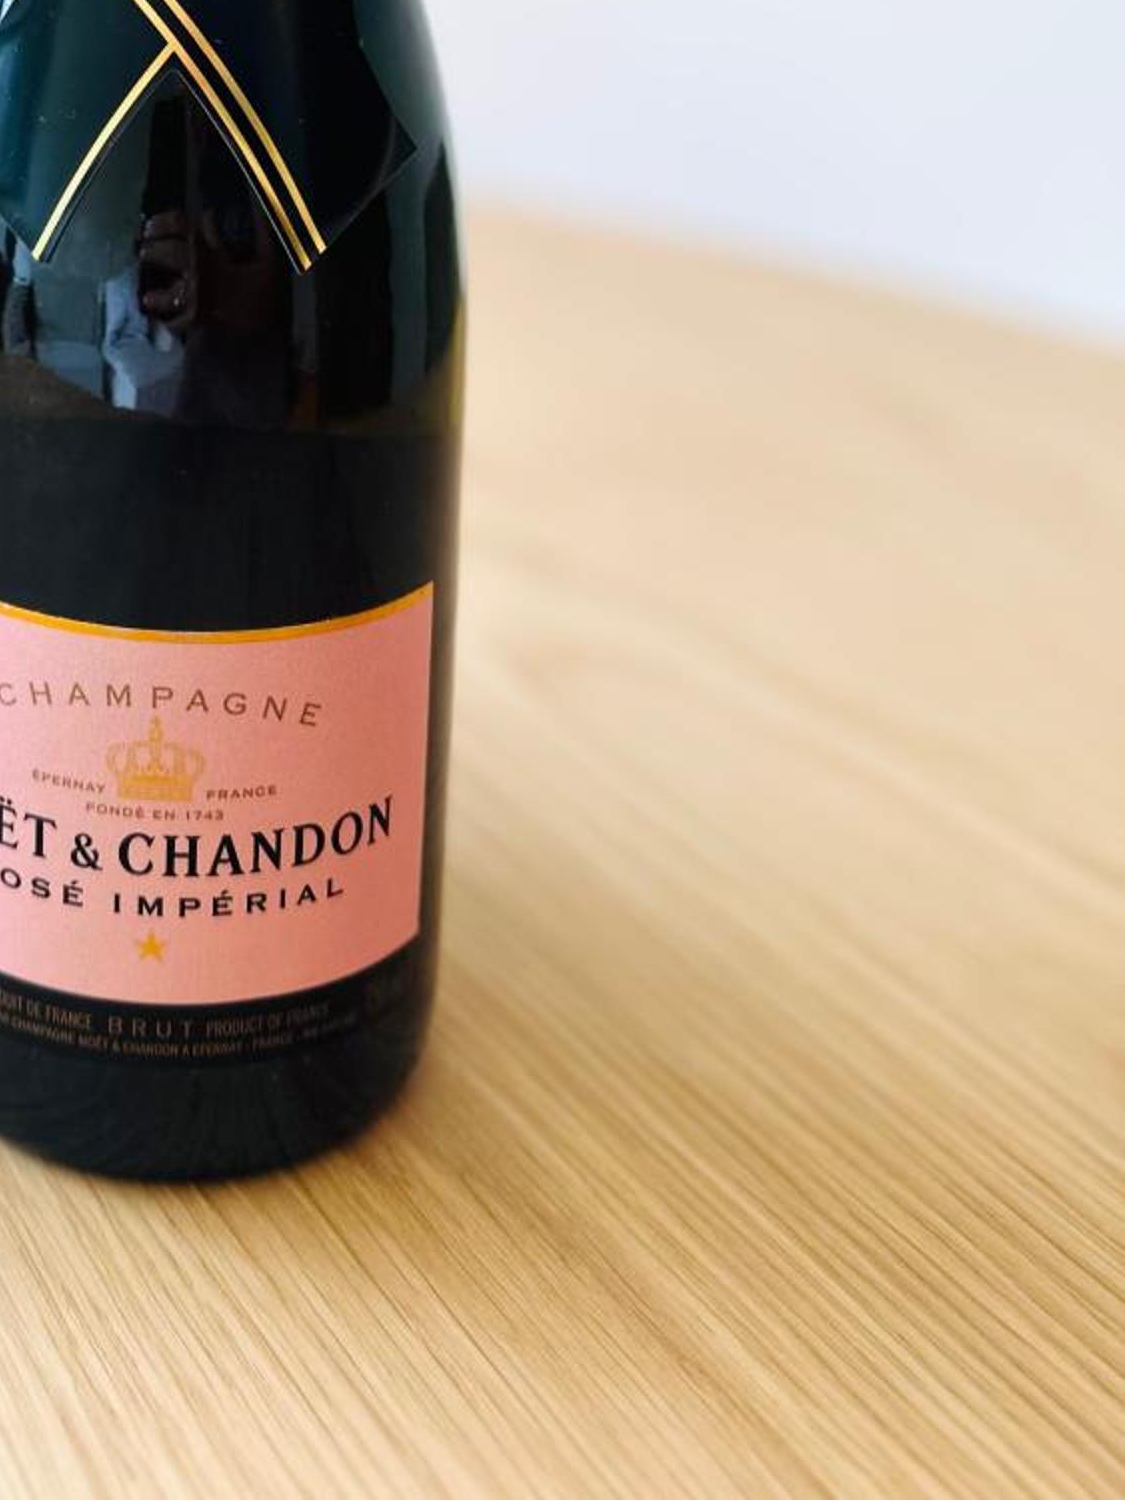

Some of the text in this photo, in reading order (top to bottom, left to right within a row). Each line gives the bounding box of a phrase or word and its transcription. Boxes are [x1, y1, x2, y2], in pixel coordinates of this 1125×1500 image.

[206, 784, 278, 800] FRANCE
[86, 802, 225, 822] FONDÉ EN 1743
[70, 833, 103, 870] &
[118, 795, 394, 878] CHANDON
[113, 877, 345, 918] IMPÉRIAL
[45, 1006, 91, 1032] FRANCE
[108, 1016, 194, 1040] BRUT
